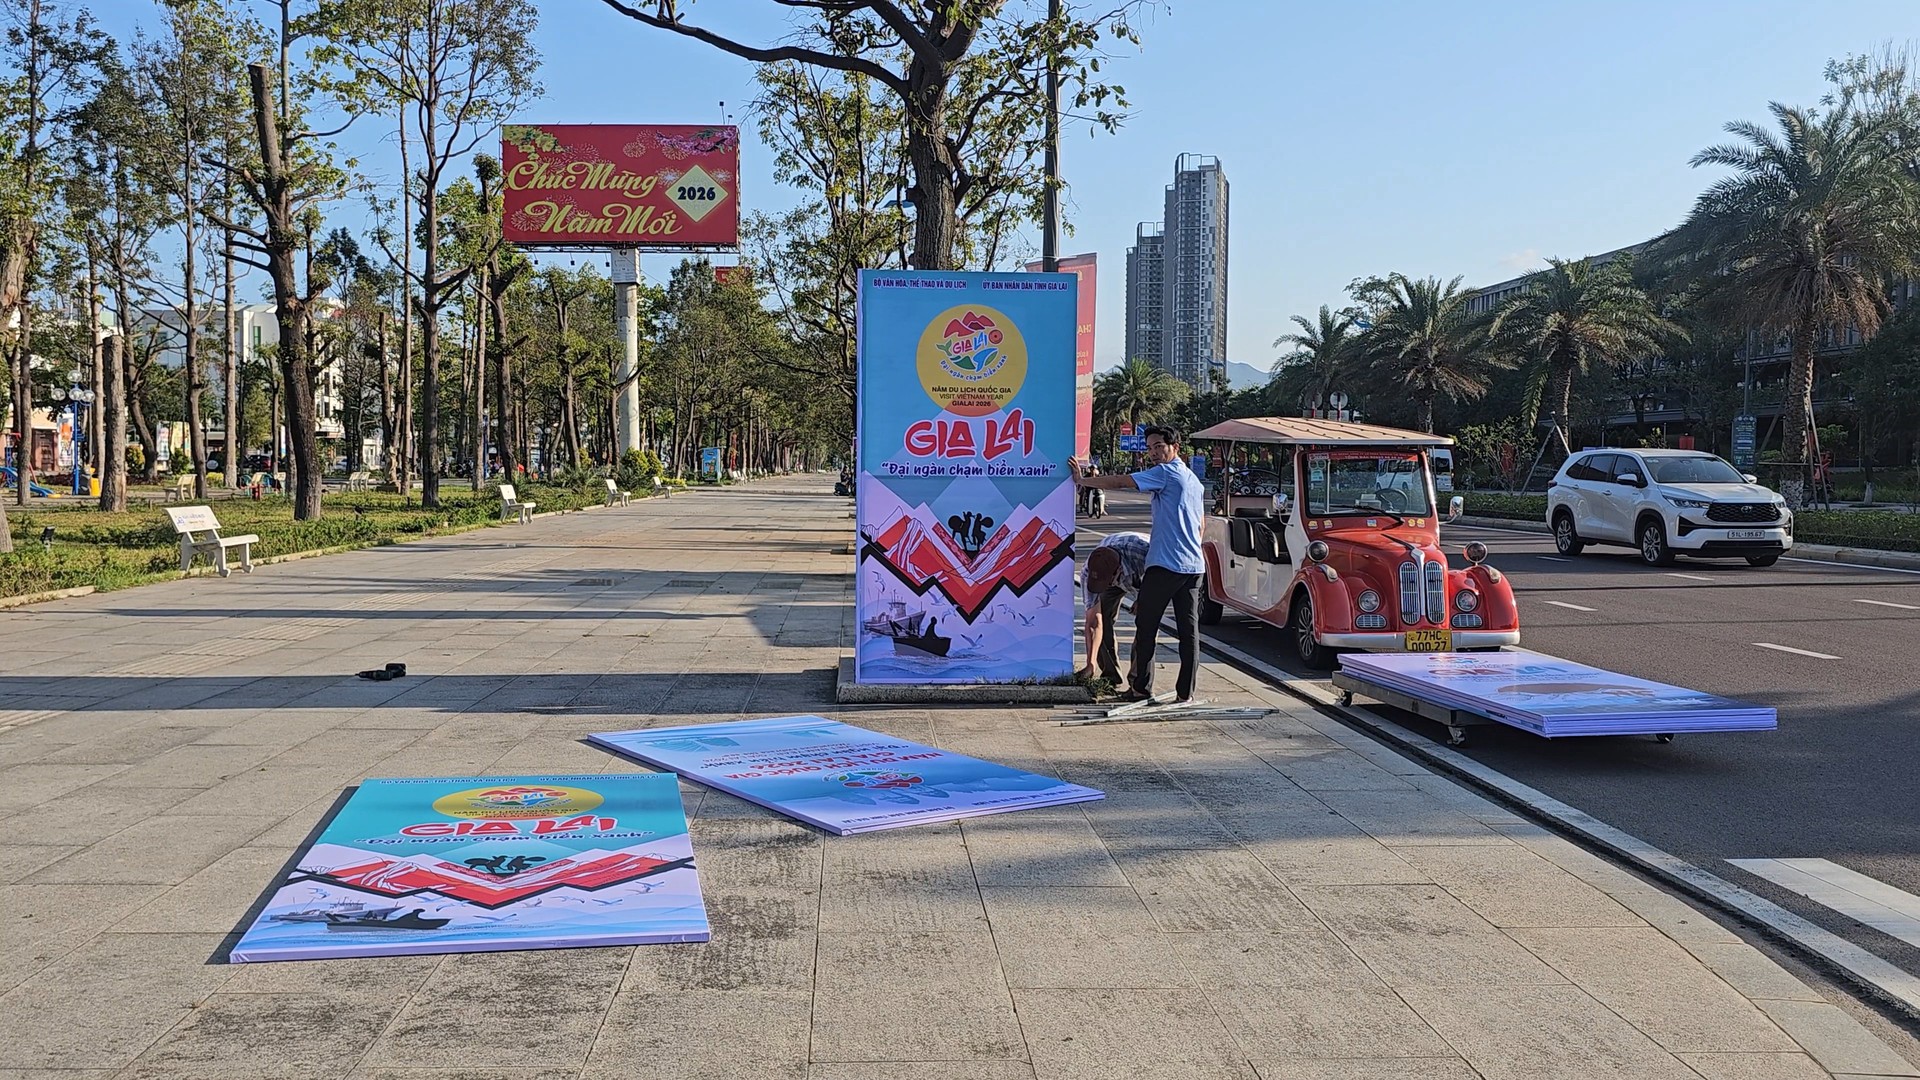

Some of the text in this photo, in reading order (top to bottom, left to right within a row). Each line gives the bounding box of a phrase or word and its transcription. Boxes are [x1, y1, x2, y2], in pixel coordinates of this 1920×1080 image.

[508, 161, 659, 198] Chúc Mừng
[677, 186, 716, 201] 2026
[523, 201, 683, 235] Năm Mới
[873, 278, 881, 288] BỘ
[921, 280, 935, 288] THAO
[936, 279, 944, 288] VÀ
[945, 280, 953, 288] DU
[954, 281, 966, 290] LỊCH
[991, 281, 1003, 290] BAN
[1004, 280, 1020, 290] NHÂN
[1021, 280, 1032, 290] DÂN
[1047, 282, 1057, 290] GIA
[1058, 282, 1068, 290] LAI
[952, 331, 988, 354] GIA LAI
[932, 385, 947, 393] NĂM
[960, 387, 976, 395] LỊCH
[977, 384, 998, 393] QUỐC
[905, 409, 1034, 461] GIA LAI
[913, 463, 945, 478] ngàn
[949, 463, 983, 478] chạm
[987, 459, 1015, 476] biển
[1416, 631, 1442, 641] 77HC
[401, 815, 617, 837] GIA LAI
